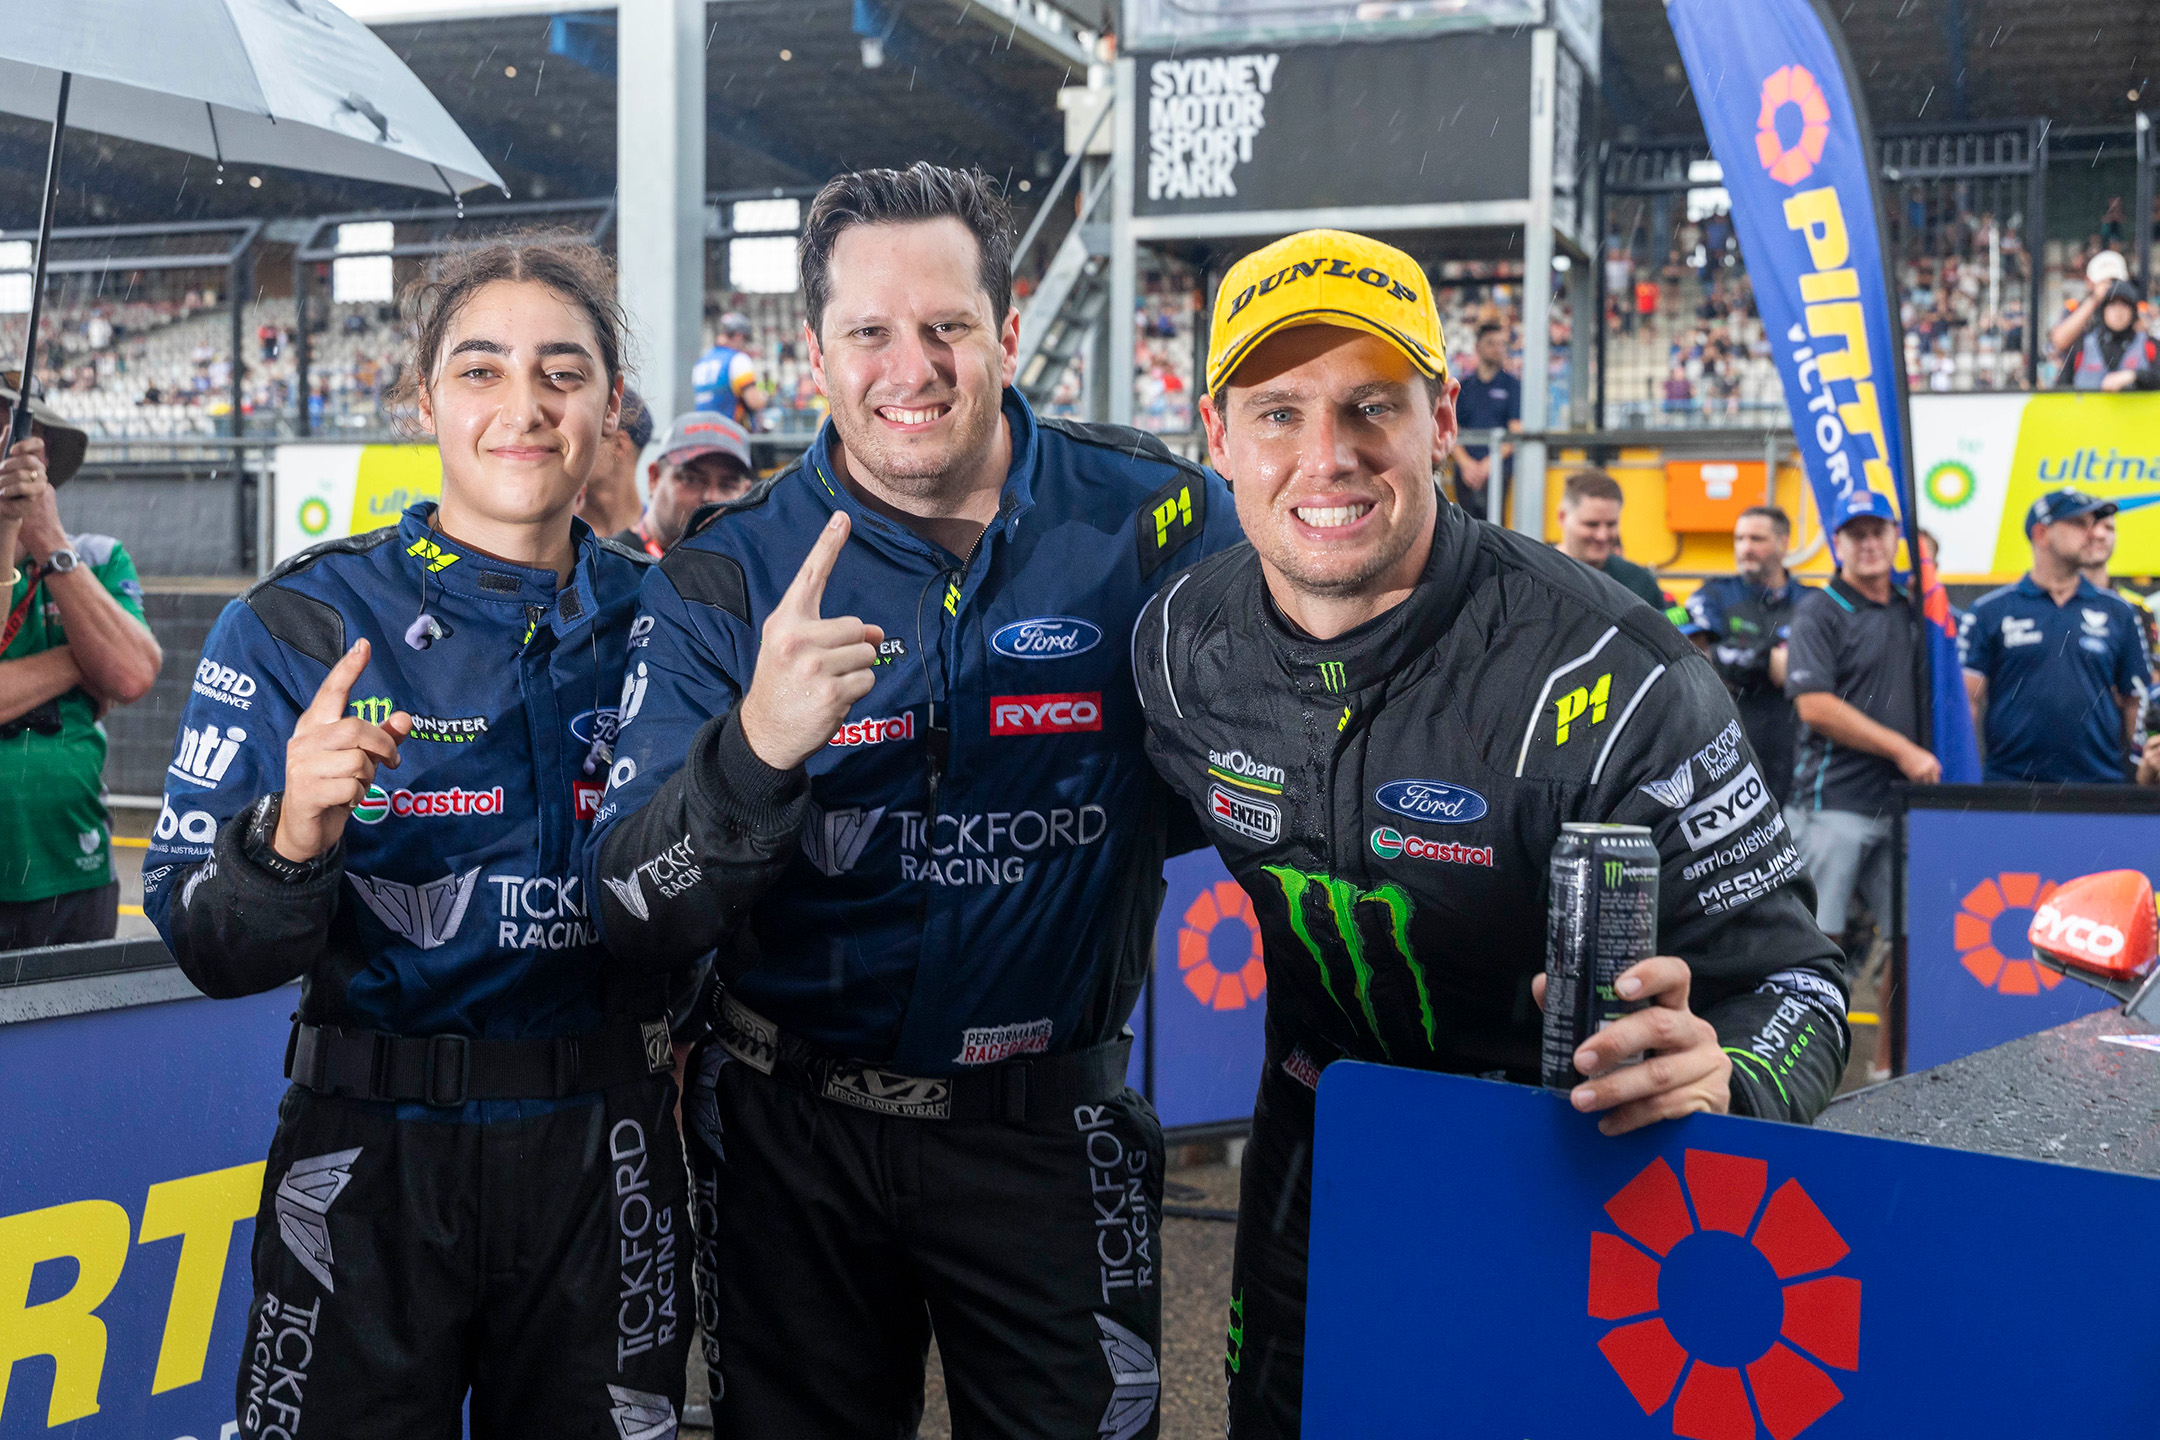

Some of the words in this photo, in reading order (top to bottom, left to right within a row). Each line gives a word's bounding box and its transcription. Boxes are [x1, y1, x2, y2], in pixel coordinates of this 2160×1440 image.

[1150, 53, 1280, 99] SYDNEY
[1149, 91, 1266, 131] MOTOR
[1149, 126, 1259, 166] SPORT
[1148, 152, 1238, 200] PARK
[1227, 258, 1418, 323] DUNLOP
[1152, 485, 1192, 548] P1
[1013, 623, 1078, 651] Ford
[195, 657, 257, 698] FORD
[412, 714, 489, 734] ONSTER
[829, 711, 915, 746] astrol
[996, 701, 1098, 727] RYCO
[1554, 672, 1612, 746] P1
[1693, 718, 1742, 771] TICKFORD
[1708, 748, 1740, 782] RACING
[391, 786, 504, 818] Castrol
[1229, 800, 1273, 833] ENZED
[1399, 784, 1466, 817] Ford
[1686, 776, 1761, 840] RYCO
[888, 804, 1107, 856] TICKFORD
[900, 854, 1025, 886] RACING
[1404, 836, 1494, 868] Castrol
[967, 1023, 1052, 1047] PERFORMANCE
[1751, 995, 1811, 1060] NSTER
[964, 1035, 1049, 1063] RACEGEAR
[902, 1101, 946, 1118] WEAR
[1127, 1149, 1153, 1289] RACING
[608, 1117, 655, 1375] TICKFORD
[656, 1206, 678, 1347] RACING
[244, 1291, 280, 1433] RACING
